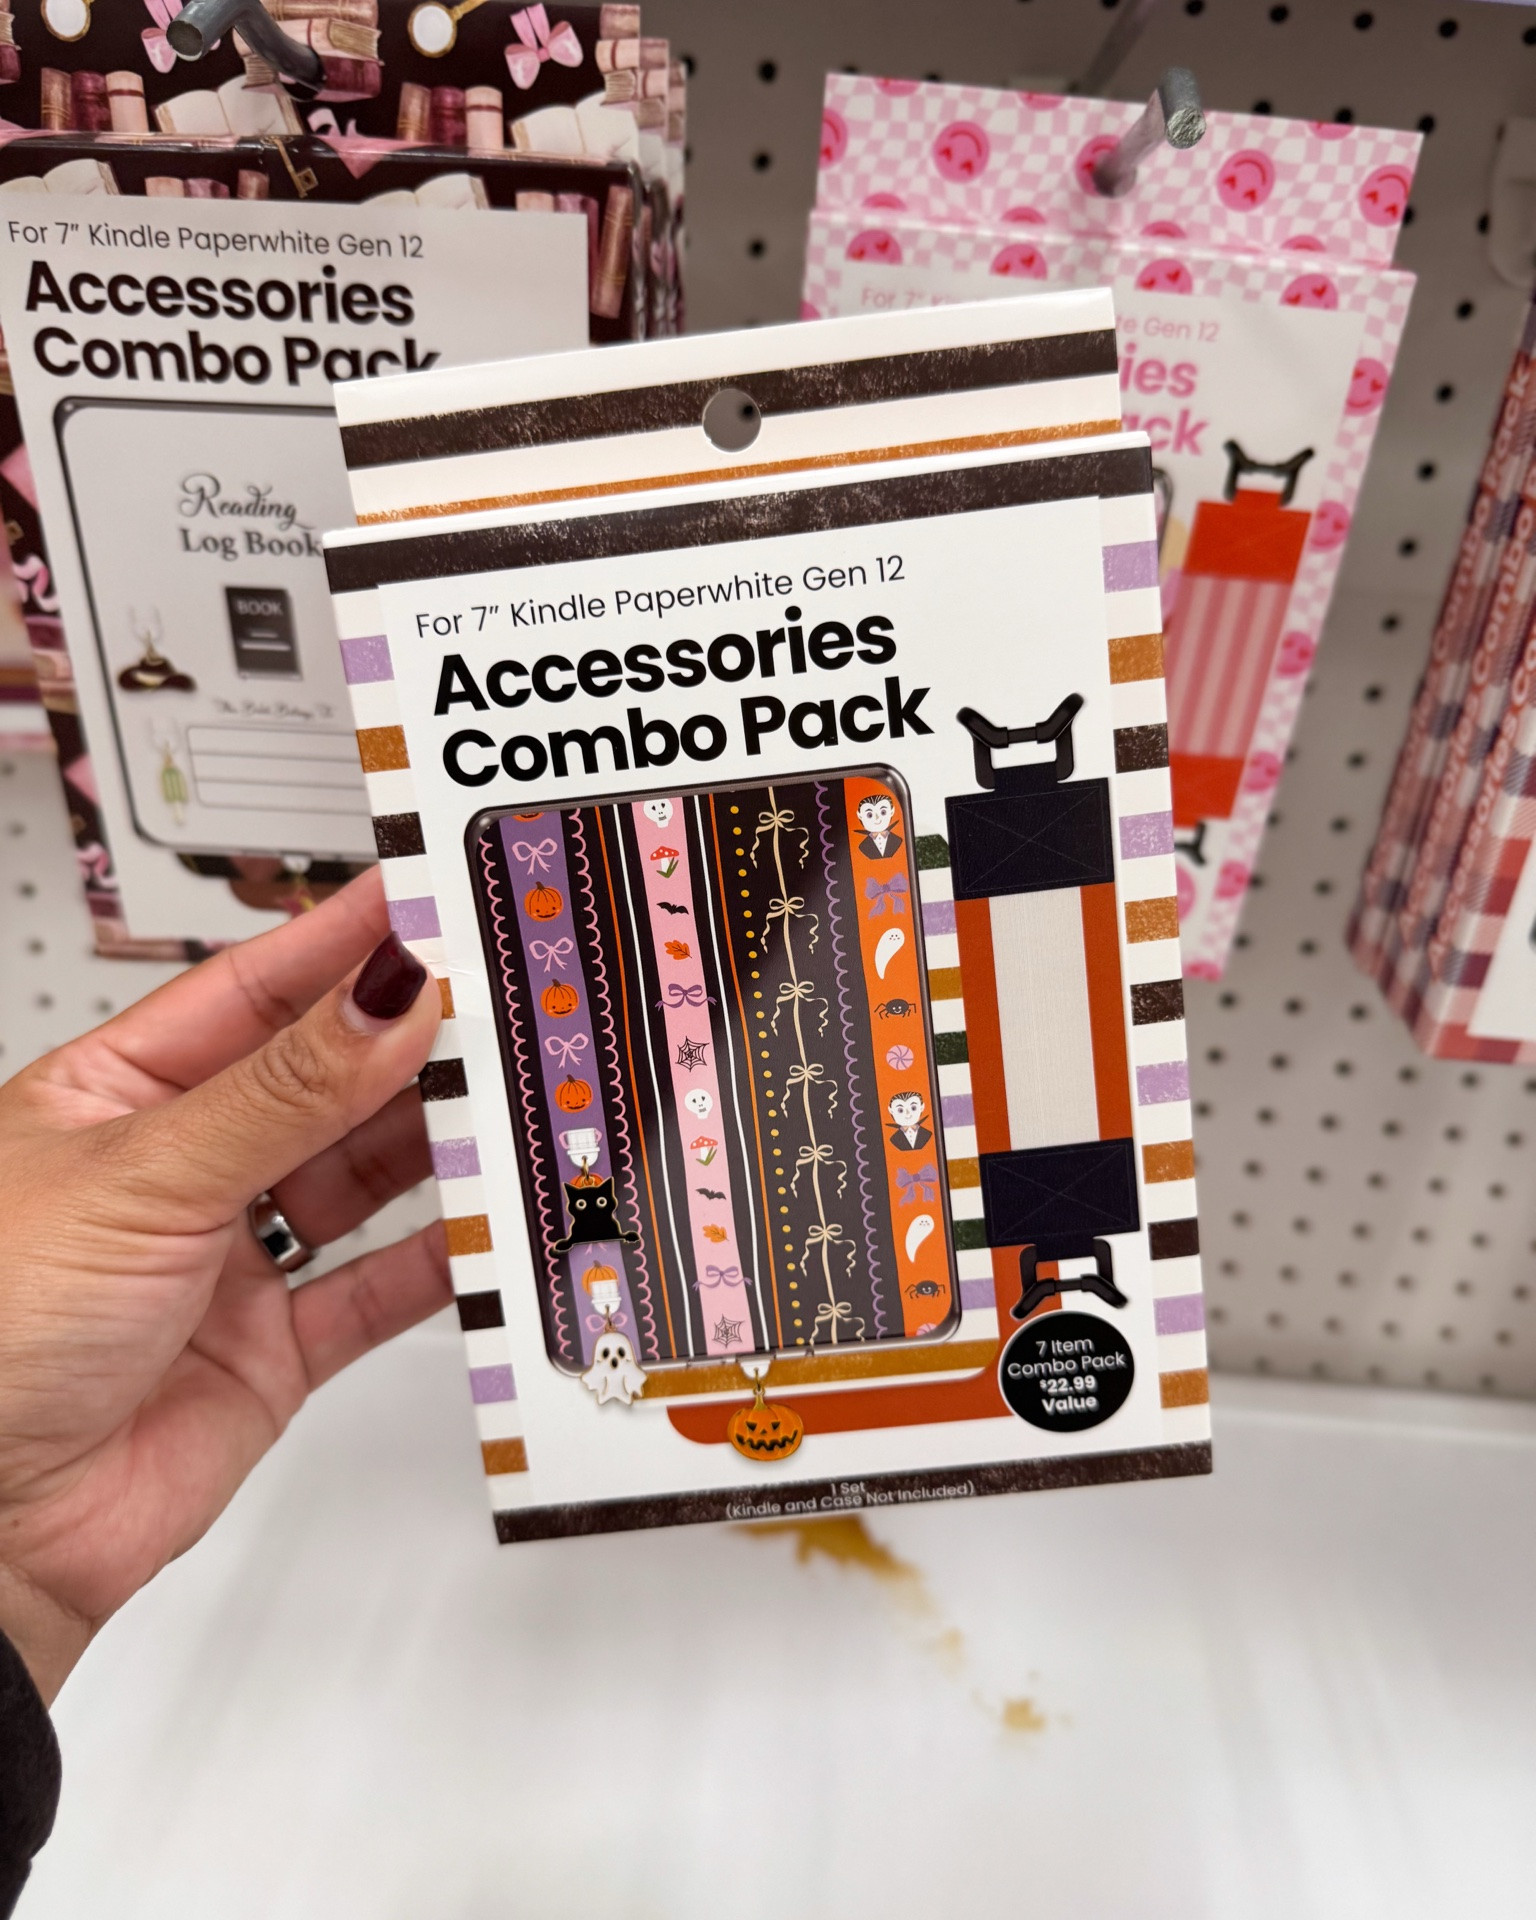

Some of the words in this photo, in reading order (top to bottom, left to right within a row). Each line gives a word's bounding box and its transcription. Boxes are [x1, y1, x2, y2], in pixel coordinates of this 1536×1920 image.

[7, 221, 48, 245] For
[88, 223, 170, 250] Kindle
[179, 227, 330, 257] Paperwhite
[338, 233, 392, 257] Gen
[399, 236, 424, 259] 12
[25, 259, 415, 327] Accessories
[1144, 317, 1191, 339] Gen
[1198, 320, 1220, 342] 12
[33, 326, 272, 386] Combo
[180, 472, 314, 530] Reading
[179, 527, 239, 561] Log
[245, 530, 323, 558] Book
[236, 599, 284, 616] BOOK
[415, 614, 463, 638] For
[510, 594, 606, 628] Kindle
[614, 570, 793, 619] Paperwhite
[802, 561, 867, 592] Gen
[876, 555, 906, 583] 12
[433, 605, 898, 717] Accessories
[442, 706, 728, 788] Combo
[740, 675, 935, 756] Pack
[1008, 1359, 1077, 1378] Combo
[1081, 1351, 1127, 1371] Pack
[1035, 1341, 1047, 1356] 7
[1051, 1339, 1094, 1354] Item
[1040, 1375, 1097, 1394] $22.99
[1042, 1396, 1099, 1415] Value
[726, 1500, 780, 1519] (Kindle
[785, 1495, 817, 1512] and
[820, 1492, 863, 1508] Case
[866, 1490, 894, 1505] Not
[898, 1480, 975, 1501] Included)
[840, 1481, 866, 1494] Set
